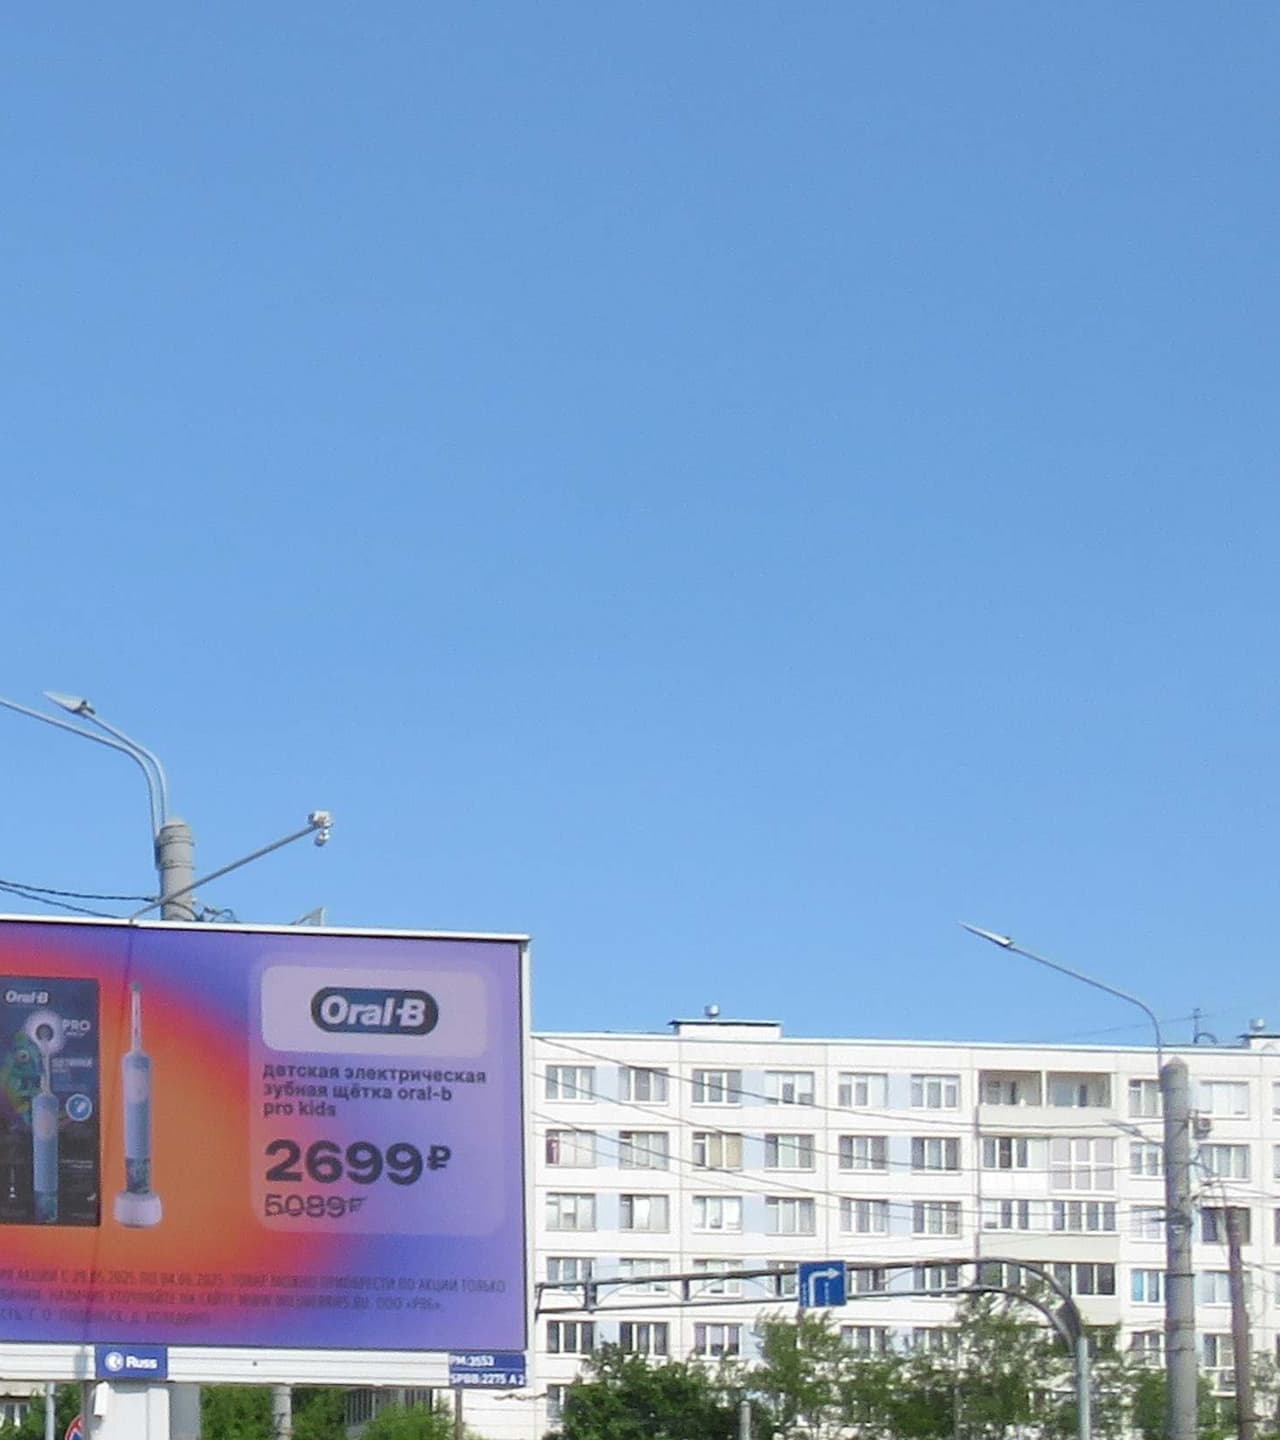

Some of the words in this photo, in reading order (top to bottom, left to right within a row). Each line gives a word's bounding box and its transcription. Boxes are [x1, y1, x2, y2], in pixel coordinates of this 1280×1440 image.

[320, 994, 426, 1028] Oral-B
[263, 1063, 340, 1080] детская
[344, 1066, 487, 1084] электрическая
[263, 1081, 328, 1098] зубная
[332, 1082, 393, 1100] щётка
[397, 1085, 453, 1101] oral-b
[263, 1102, 294, 1118] pro
[299, 1101, 337, 1117] kids
[125, 1355, 158, 1370] Russ
